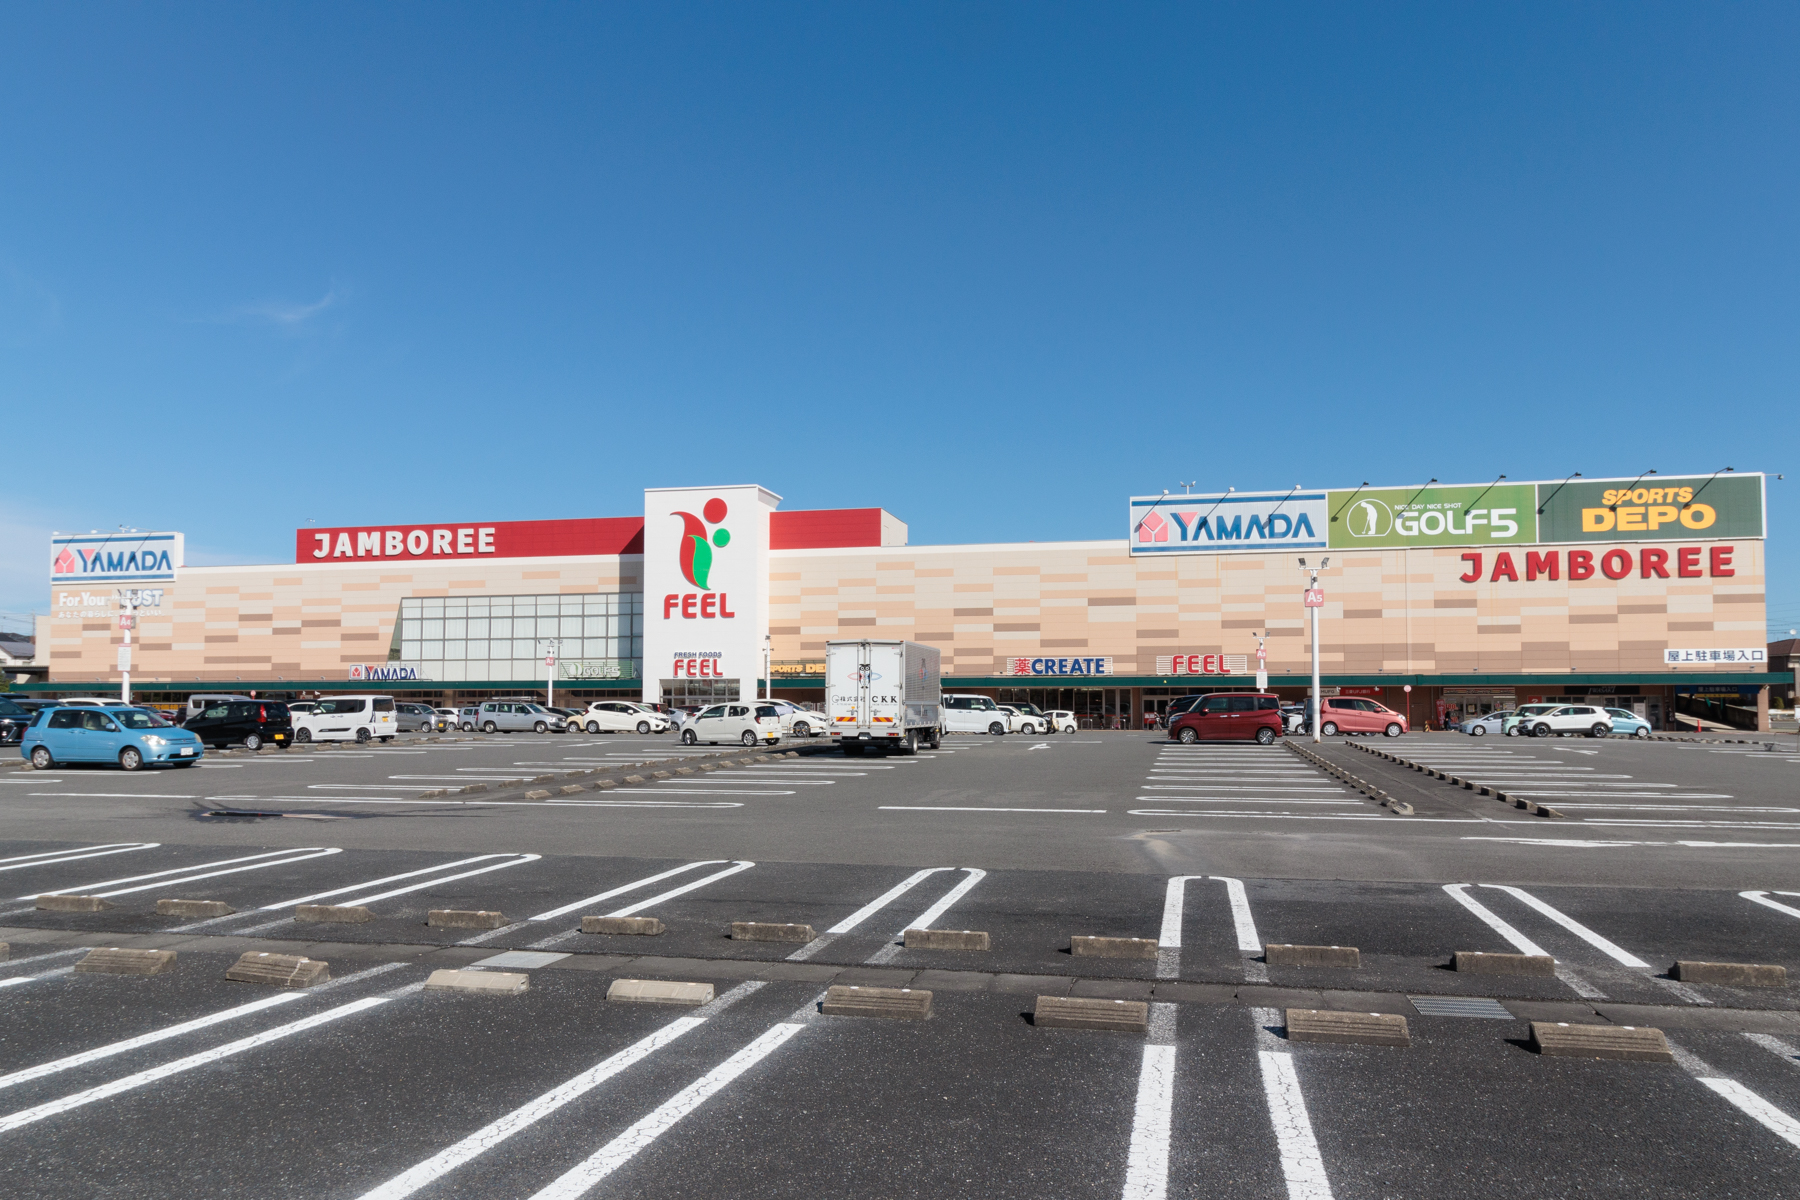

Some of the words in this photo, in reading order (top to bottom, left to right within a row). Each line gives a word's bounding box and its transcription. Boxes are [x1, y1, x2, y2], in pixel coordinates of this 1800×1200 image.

[1602, 486, 1694, 506] SPORTS
[1169, 511, 1316, 542] YAMADA
[1394, 508, 1519, 538] GOLF5
[1582, 503, 1717, 533] DEPO
[312, 527, 496, 559] JAMBOREE
[76, 548, 173, 573] YAMADA
[1459, 545, 1736, 583] JAMBOREE
[59, 592, 80, 607] For
[663, 592, 736, 620] FEEL
[1307, 591, 1323, 603] A5
[120, 616, 131, 626] A4
[674, 651, 697, 659] FRESH
[698, 651, 722, 659] FOODS
[1171, 654, 1231, 674] FEEL
[1668, 650, 1763, 662] 屋上駐車場入口
[365, 665, 416, 680] YAMADA
[673, 659, 724, 678] FEEL
[770, 664, 804, 673] PORTS
[1031, 658, 1105, 675] CREATE
